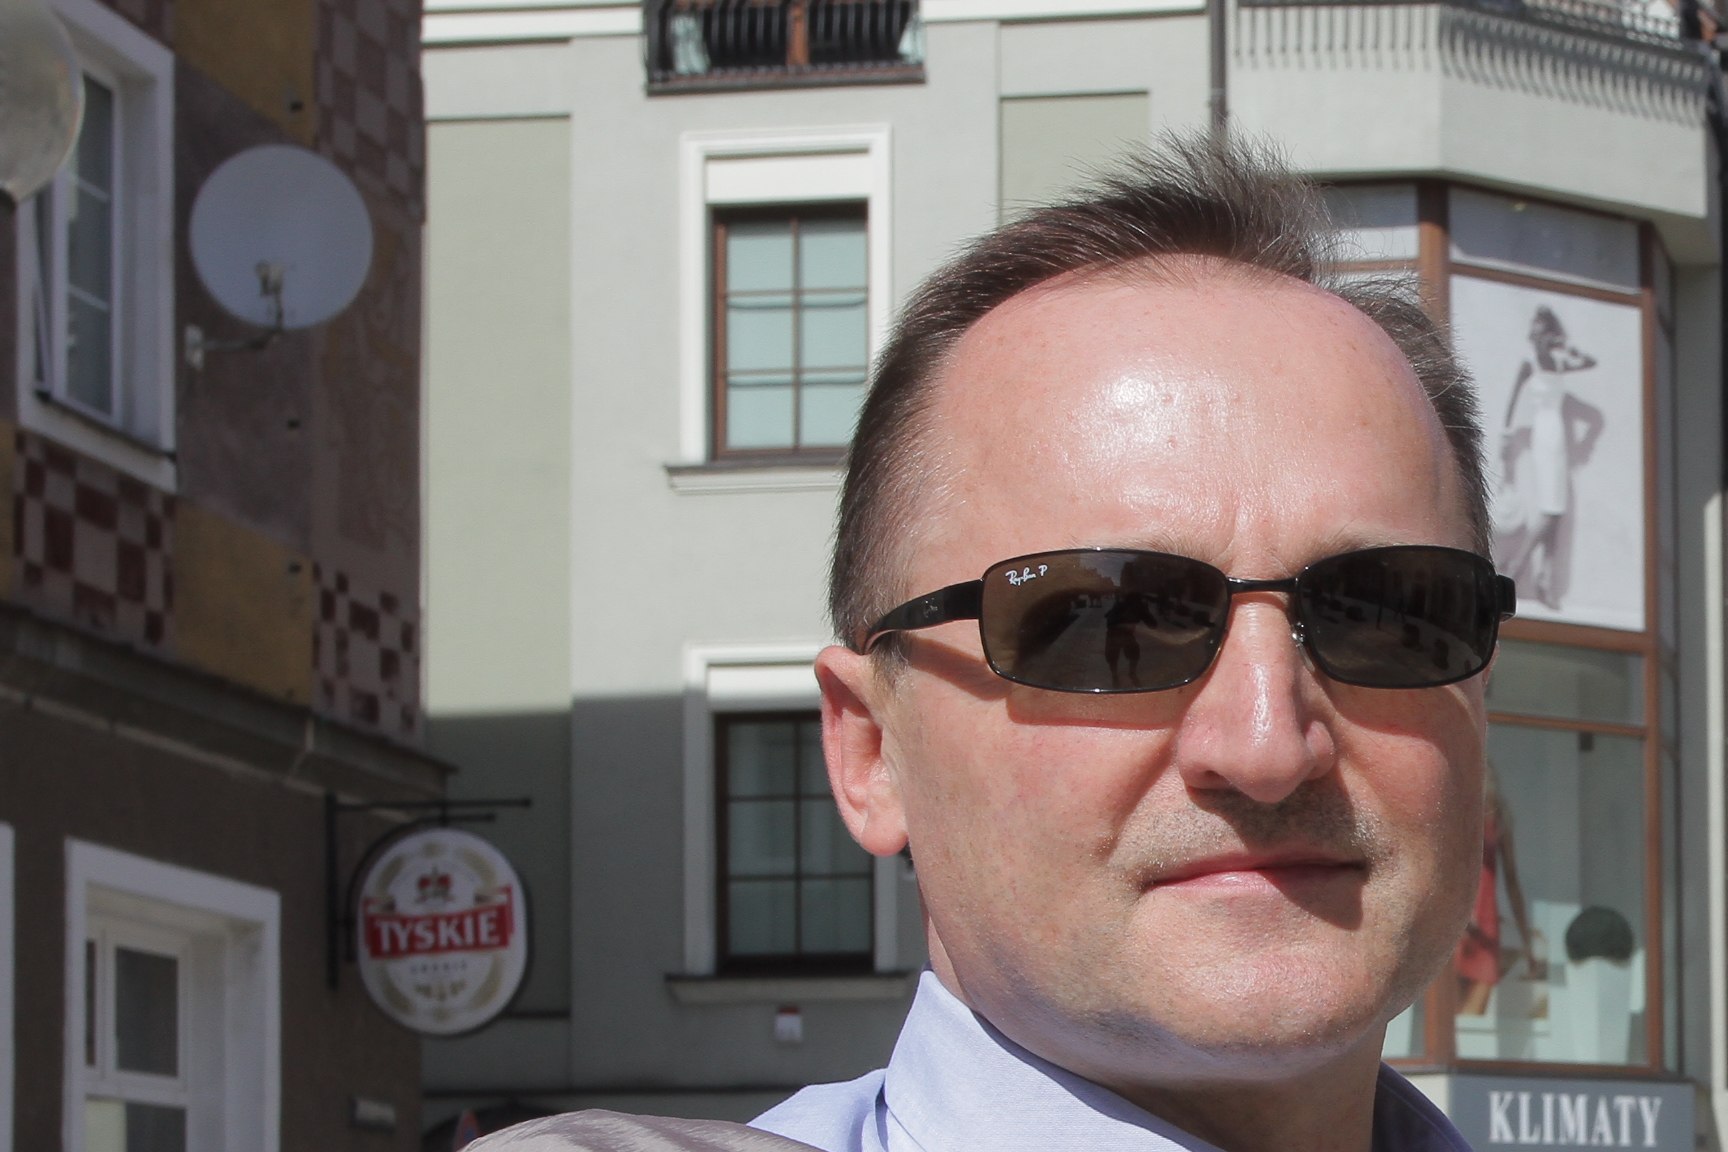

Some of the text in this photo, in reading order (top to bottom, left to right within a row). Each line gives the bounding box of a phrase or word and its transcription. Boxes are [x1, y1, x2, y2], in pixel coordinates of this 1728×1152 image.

[1005, 566, 1037, 586] Ray-Ban
[376, 911, 500, 952] TYSKIE
[1488, 1090, 1663, 1148] KLIMATY
